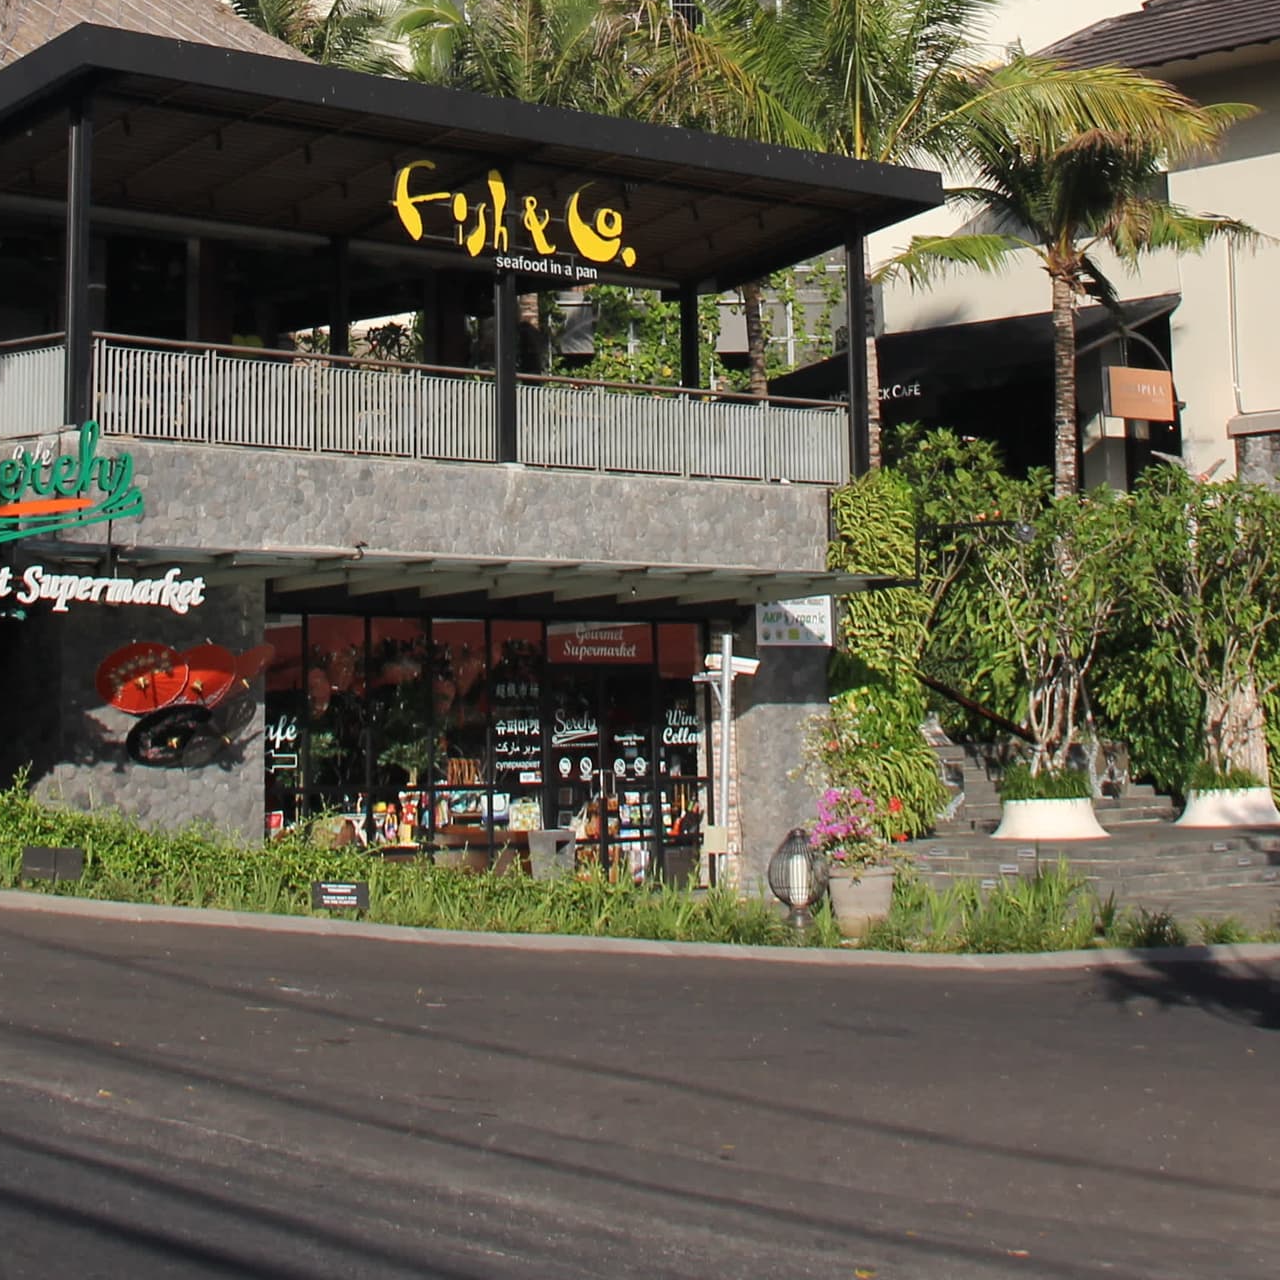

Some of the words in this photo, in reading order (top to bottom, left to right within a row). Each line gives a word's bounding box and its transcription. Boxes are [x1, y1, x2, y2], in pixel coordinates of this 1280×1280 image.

[392, 160, 509, 257] Fish
[523, 195, 557, 255] &
[566, 181, 637, 268] Co.
[496, 255, 548, 273] seafood
[550, 260, 562, 275] in
[564, 266, 572, 276] a
[576, 266, 598, 280] pan
[17, 566, 205, 614] Supermarket
[576, 623, 624, 641] Gourmet
[563, 639, 637, 660] Supermarket
[495, 719, 541, 736] 슈퍼마켓
[665, 708, 702, 726] Wine
